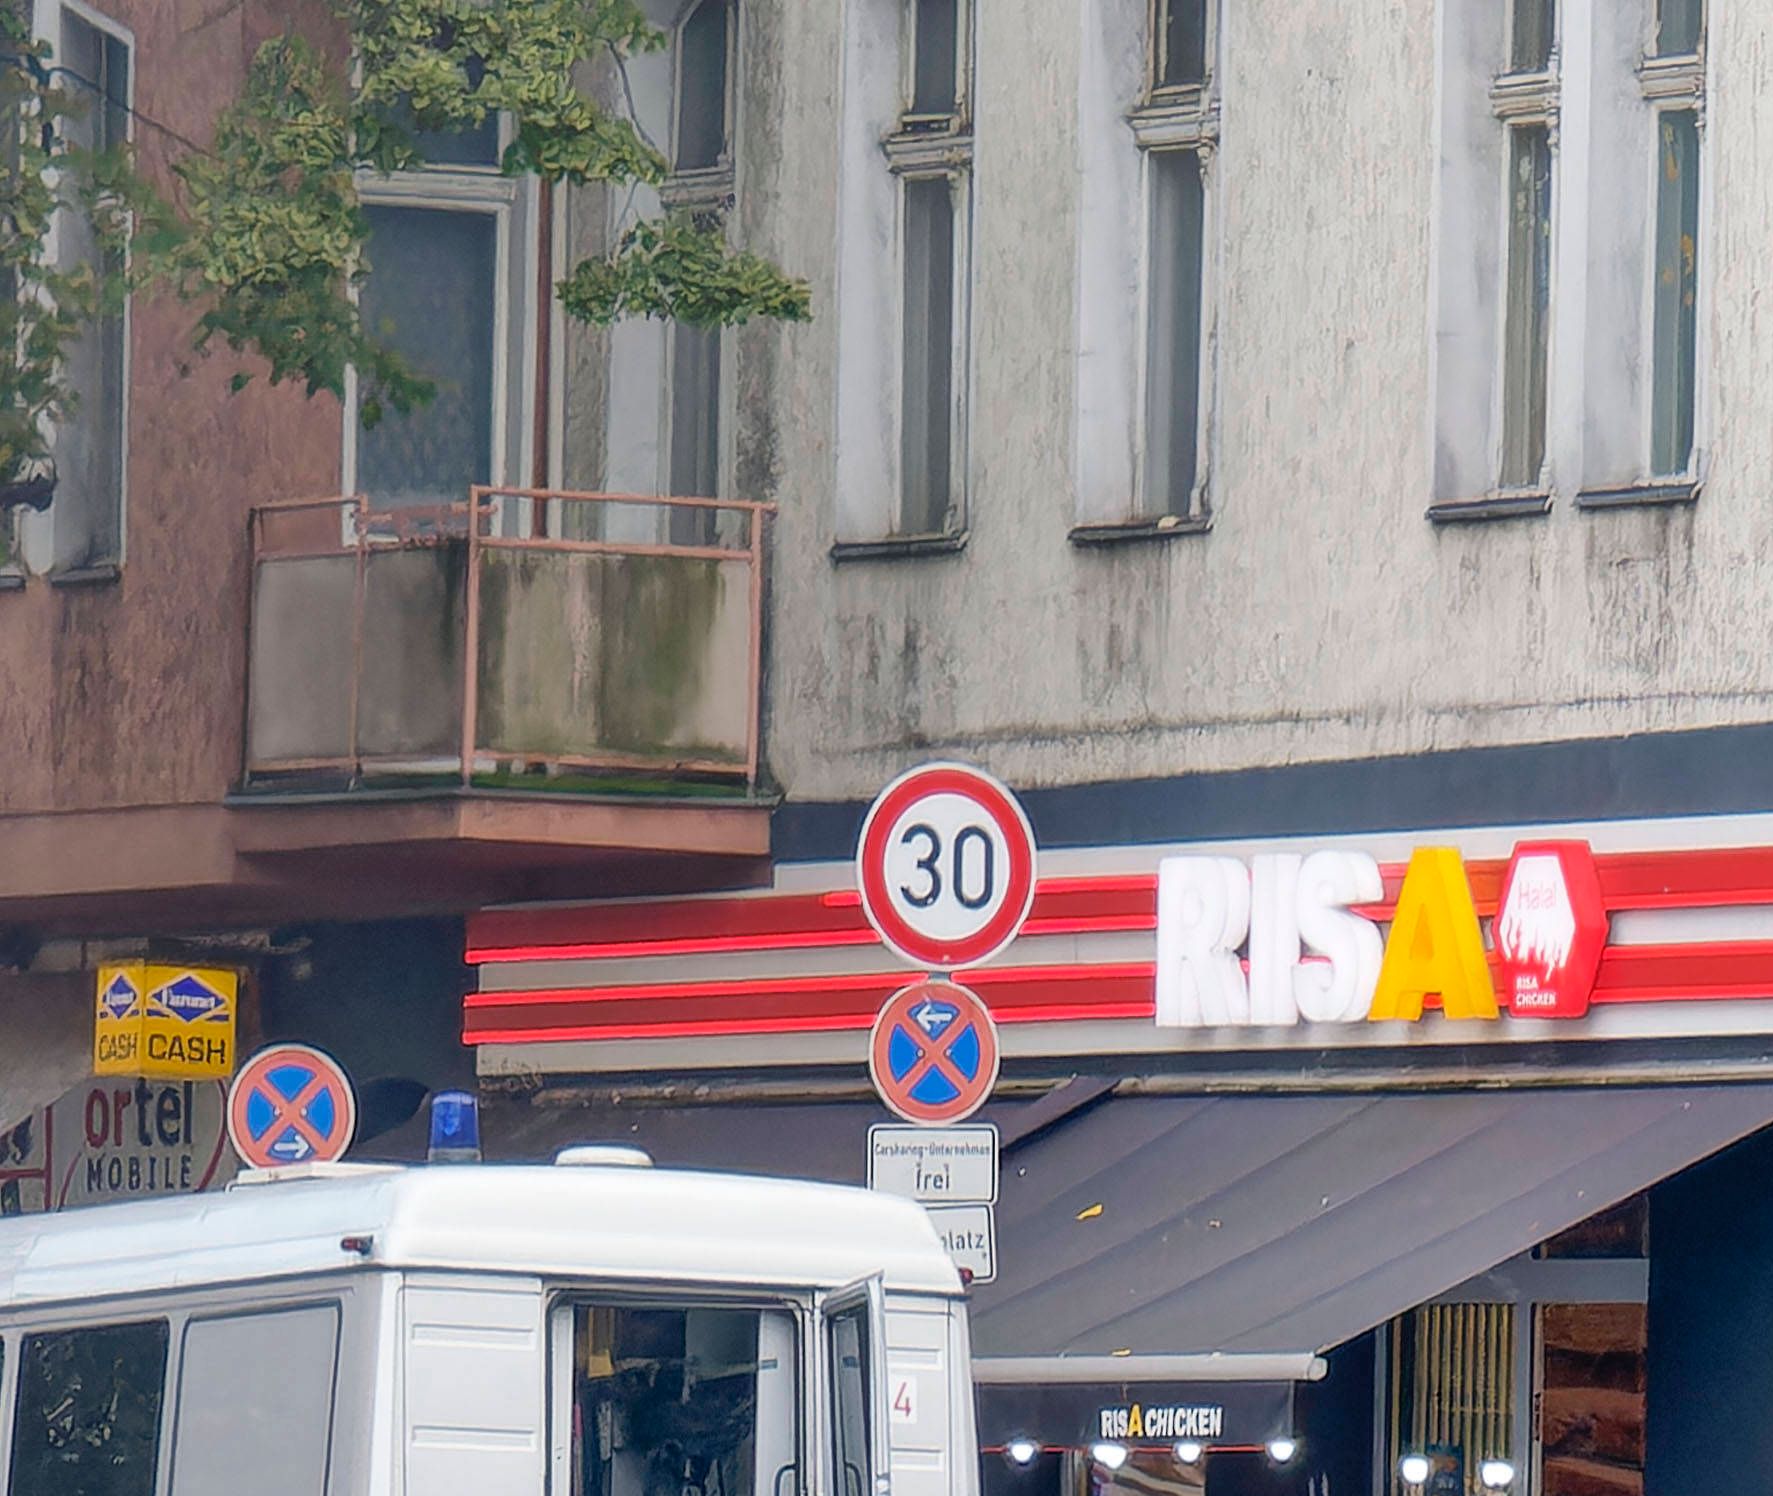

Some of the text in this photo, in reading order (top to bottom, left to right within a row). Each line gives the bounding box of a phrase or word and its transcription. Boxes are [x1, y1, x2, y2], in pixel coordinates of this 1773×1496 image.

[900, 823, 994, 909] 30
[1155, 845, 1500, 1027] RISA
[1515, 991, 1557, 1007] CHICKEN
[98, 1031, 138, 1062] CASH
[147, 1032, 227, 1065] CASH
[85, 1077, 193, 1148] ortel
[86, 1153, 193, 1193] MOBILE
[915, 1162, 950, 1191] frei
[894, 1381, 912, 1418] 4
[1145, 1406, 1223, 1438] CHICKEN
